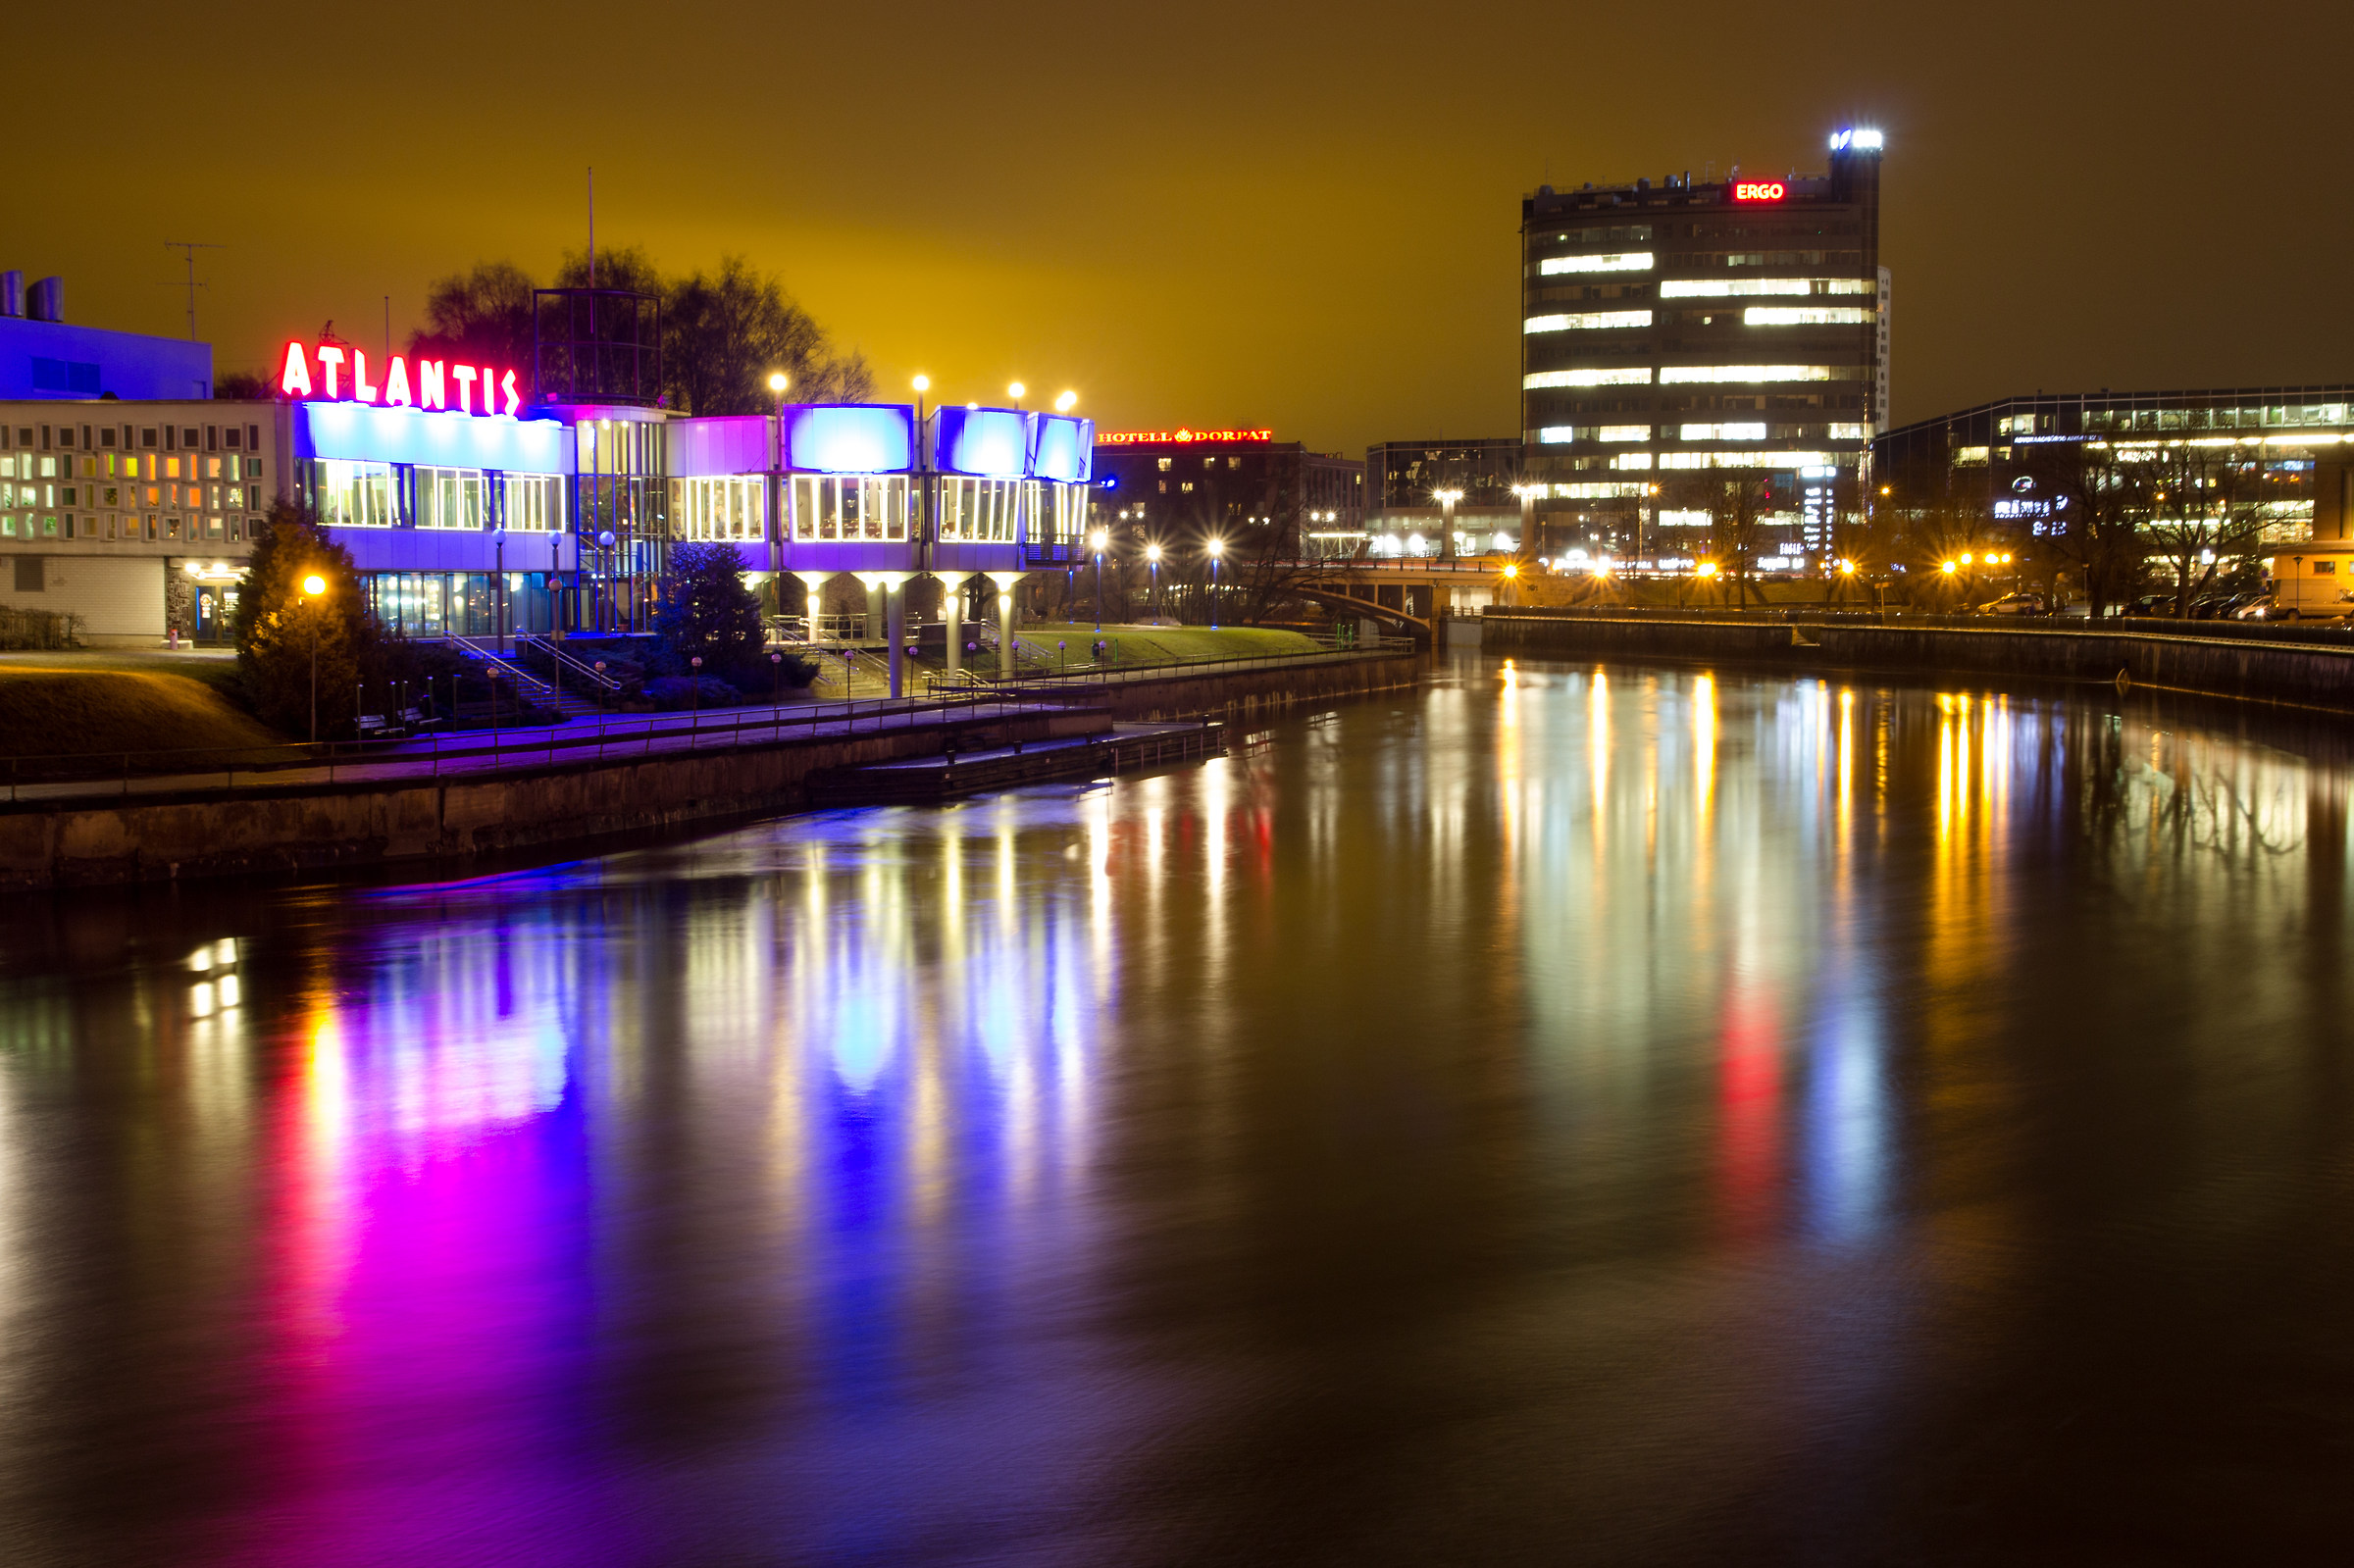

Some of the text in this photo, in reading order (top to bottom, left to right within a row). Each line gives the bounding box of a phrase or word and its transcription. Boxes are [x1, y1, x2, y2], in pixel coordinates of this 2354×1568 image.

[1736, 183, 1783, 200] ERGO
[281, 341, 521, 416] ATLANTIS
[1098, 430, 1271, 443] HOTELL DORPAT
